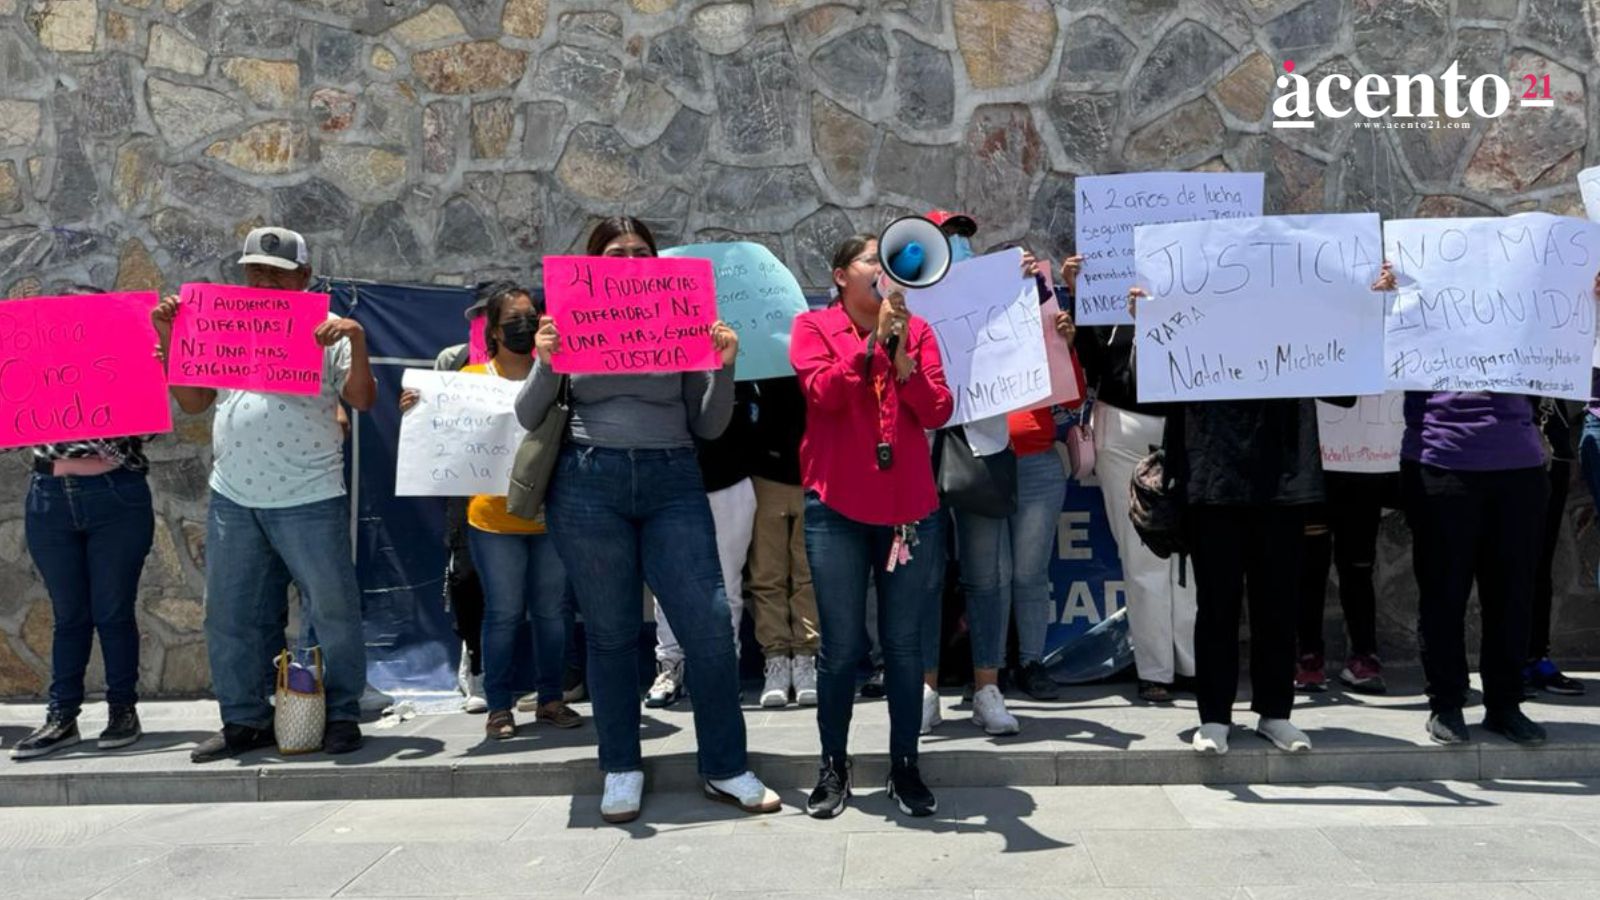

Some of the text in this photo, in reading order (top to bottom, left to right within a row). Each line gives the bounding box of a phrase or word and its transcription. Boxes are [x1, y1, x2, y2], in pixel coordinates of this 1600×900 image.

[1082, 183, 1243, 215] A 2 años de lucha
[1107, 246, 1118, 258] el
[1396, 228, 1468, 275] NO
[1147, 236, 1374, 298] JUSTICIA
[571, 263, 699, 299] 4 AUDIENCIAS
[187, 289, 290, 313] 4 AUDIENCIAS
[672, 297, 700, 317] NI
[1147, 305, 1206, 347] PARA
[181, 338, 206, 357] NI
[216, 344, 247, 358] UNA
[568, 335, 608, 352] UNA
[182, 361, 262, 376] EXIGIMOS
[601, 347, 689, 371] JUSTICIA
[1168, 339, 1346, 395] Natalie y Michelle
[966, 367, 1044, 411] MICHELLE
[15, 391, 113, 437] cuida
[432, 414, 497, 433] porque
[435, 442, 511, 457] 2 años
[431, 468, 460, 481] en
[470, 462, 492, 479] la
